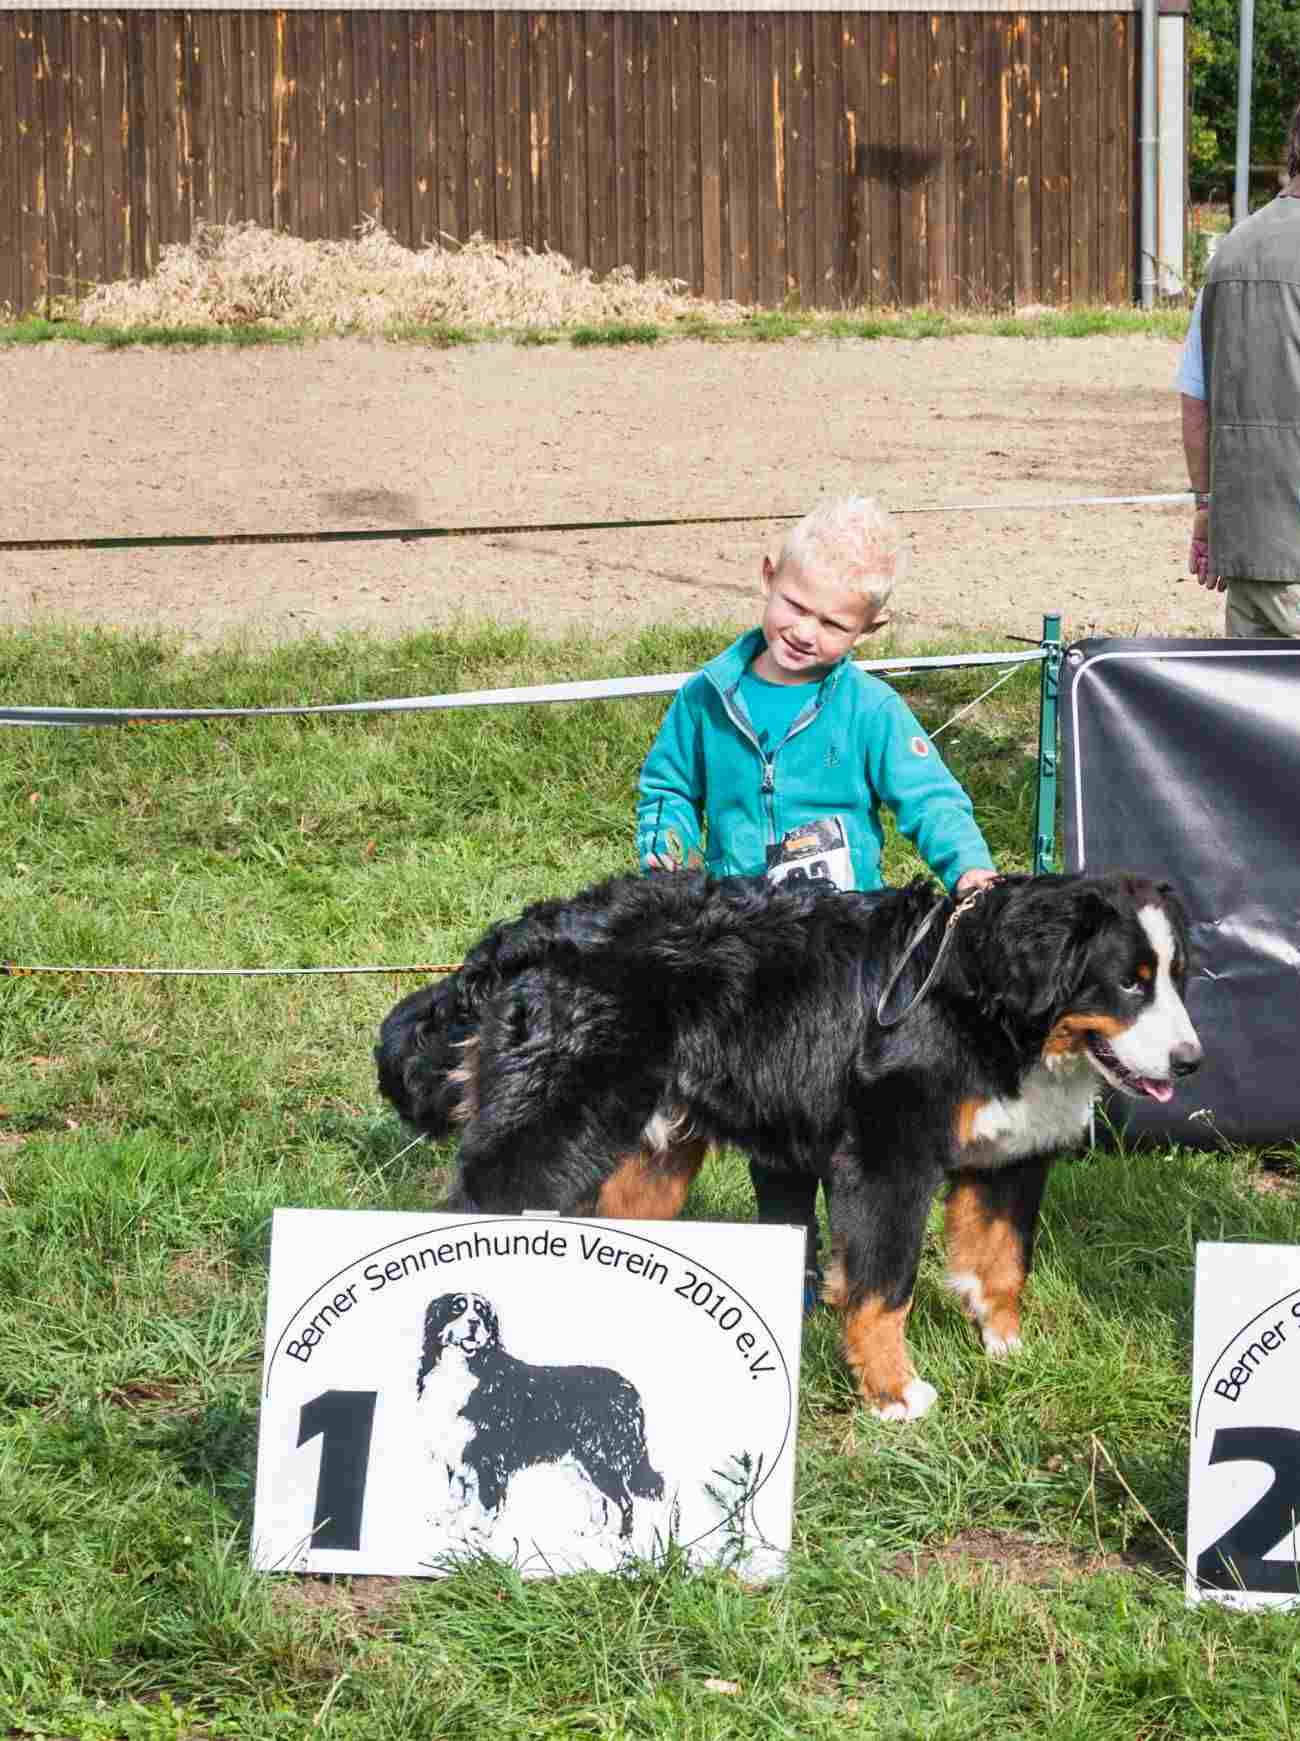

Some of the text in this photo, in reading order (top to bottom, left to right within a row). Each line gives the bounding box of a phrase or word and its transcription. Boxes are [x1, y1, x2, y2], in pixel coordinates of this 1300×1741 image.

[285, 1229, 777, 1381] Berner Sennenhunde Verein 2010 e.V.
[1213, 1320, 1287, 1403] Berner
[296, 1390, 378, 1551] 1
